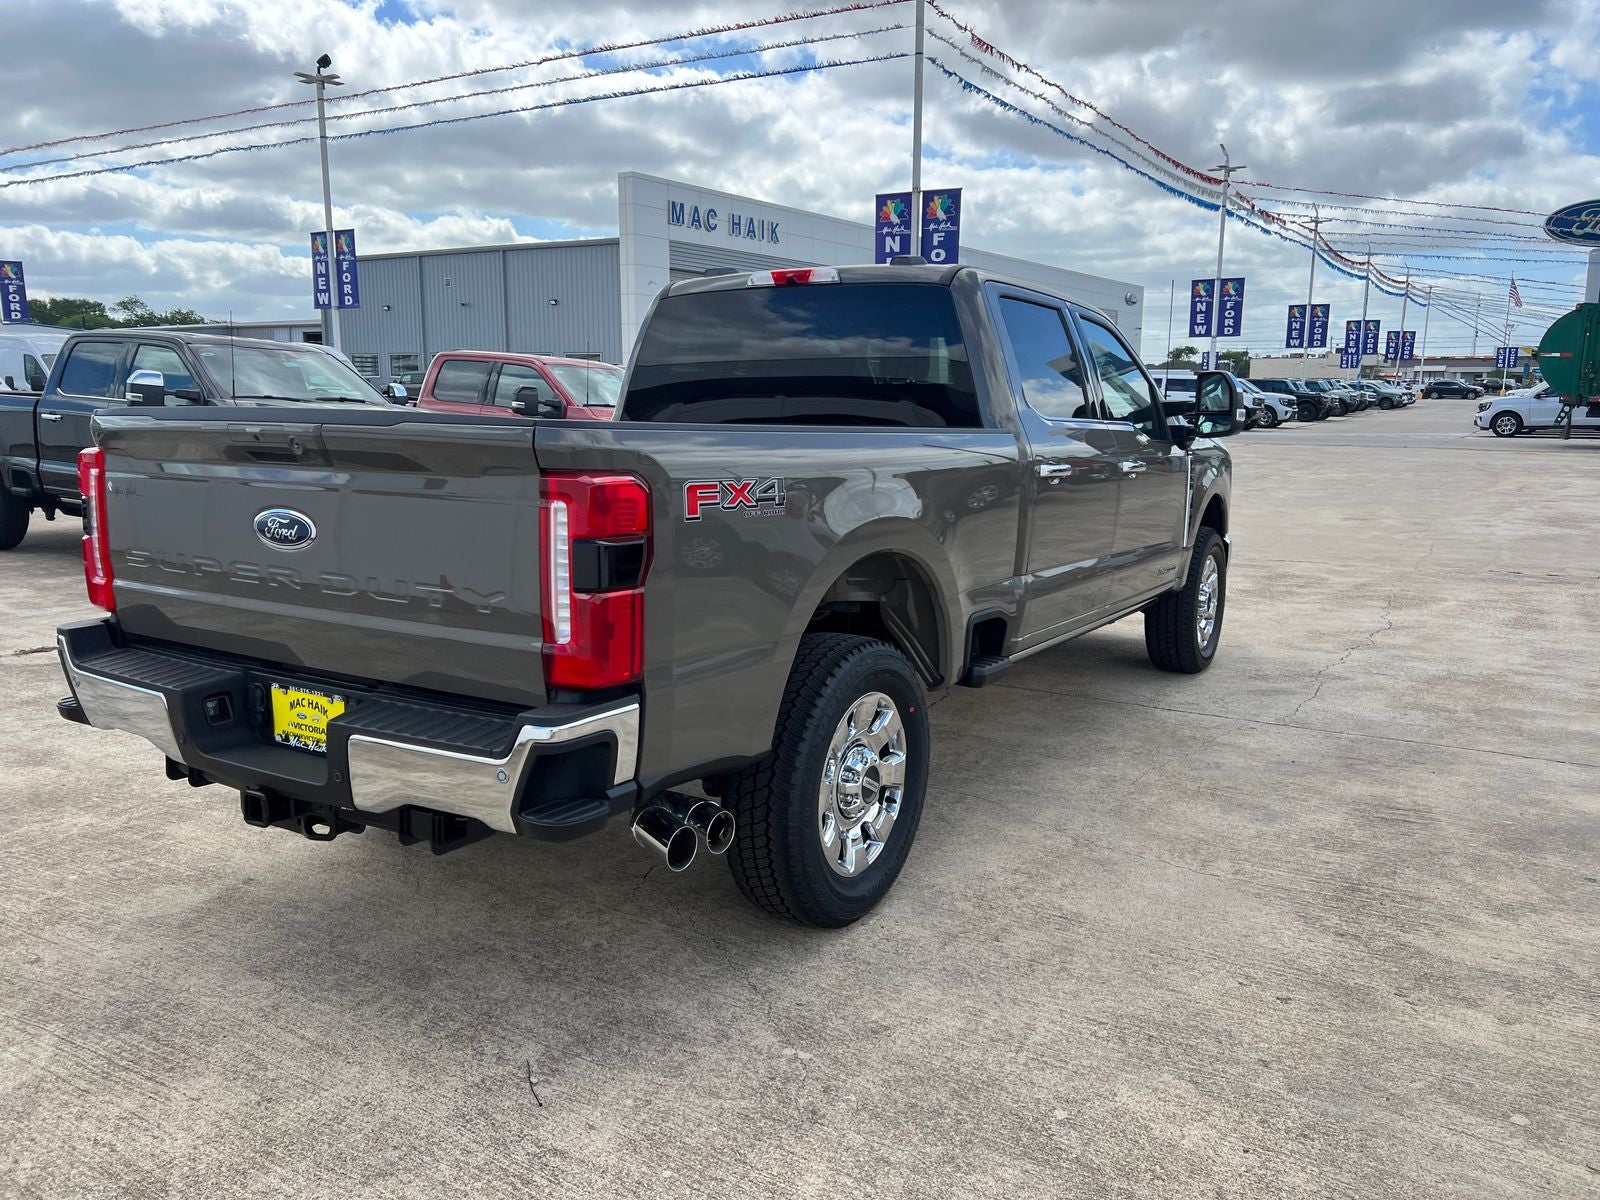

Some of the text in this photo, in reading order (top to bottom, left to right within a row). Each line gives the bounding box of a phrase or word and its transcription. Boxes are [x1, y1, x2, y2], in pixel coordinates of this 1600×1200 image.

[669, 200, 780, 243] MAC HAIK
[930, 232, 946, 262] FO
[317, 262, 329, 304] NEW
[342, 261, 353, 305] FORD
[8, 284, 21, 319] FORD
[1224, 301, 1235, 335] FORD
[1194, 302, 1206, 335] NEW
[1290, 321, 1300, 346] NEW
[1313, 321, 1322, 346] FORD
[1348, 334, 1356, 354] NEW
[1387, 342, 1395, 358] NEW
[683, 477, 786, 522] FX4
[265, 516, 298, 540] Ford
[126, 550, 505, 614] SUPER DUTY
[290, 698, 306, 711] MAC
[307, 698, 329, 719] HAIK
